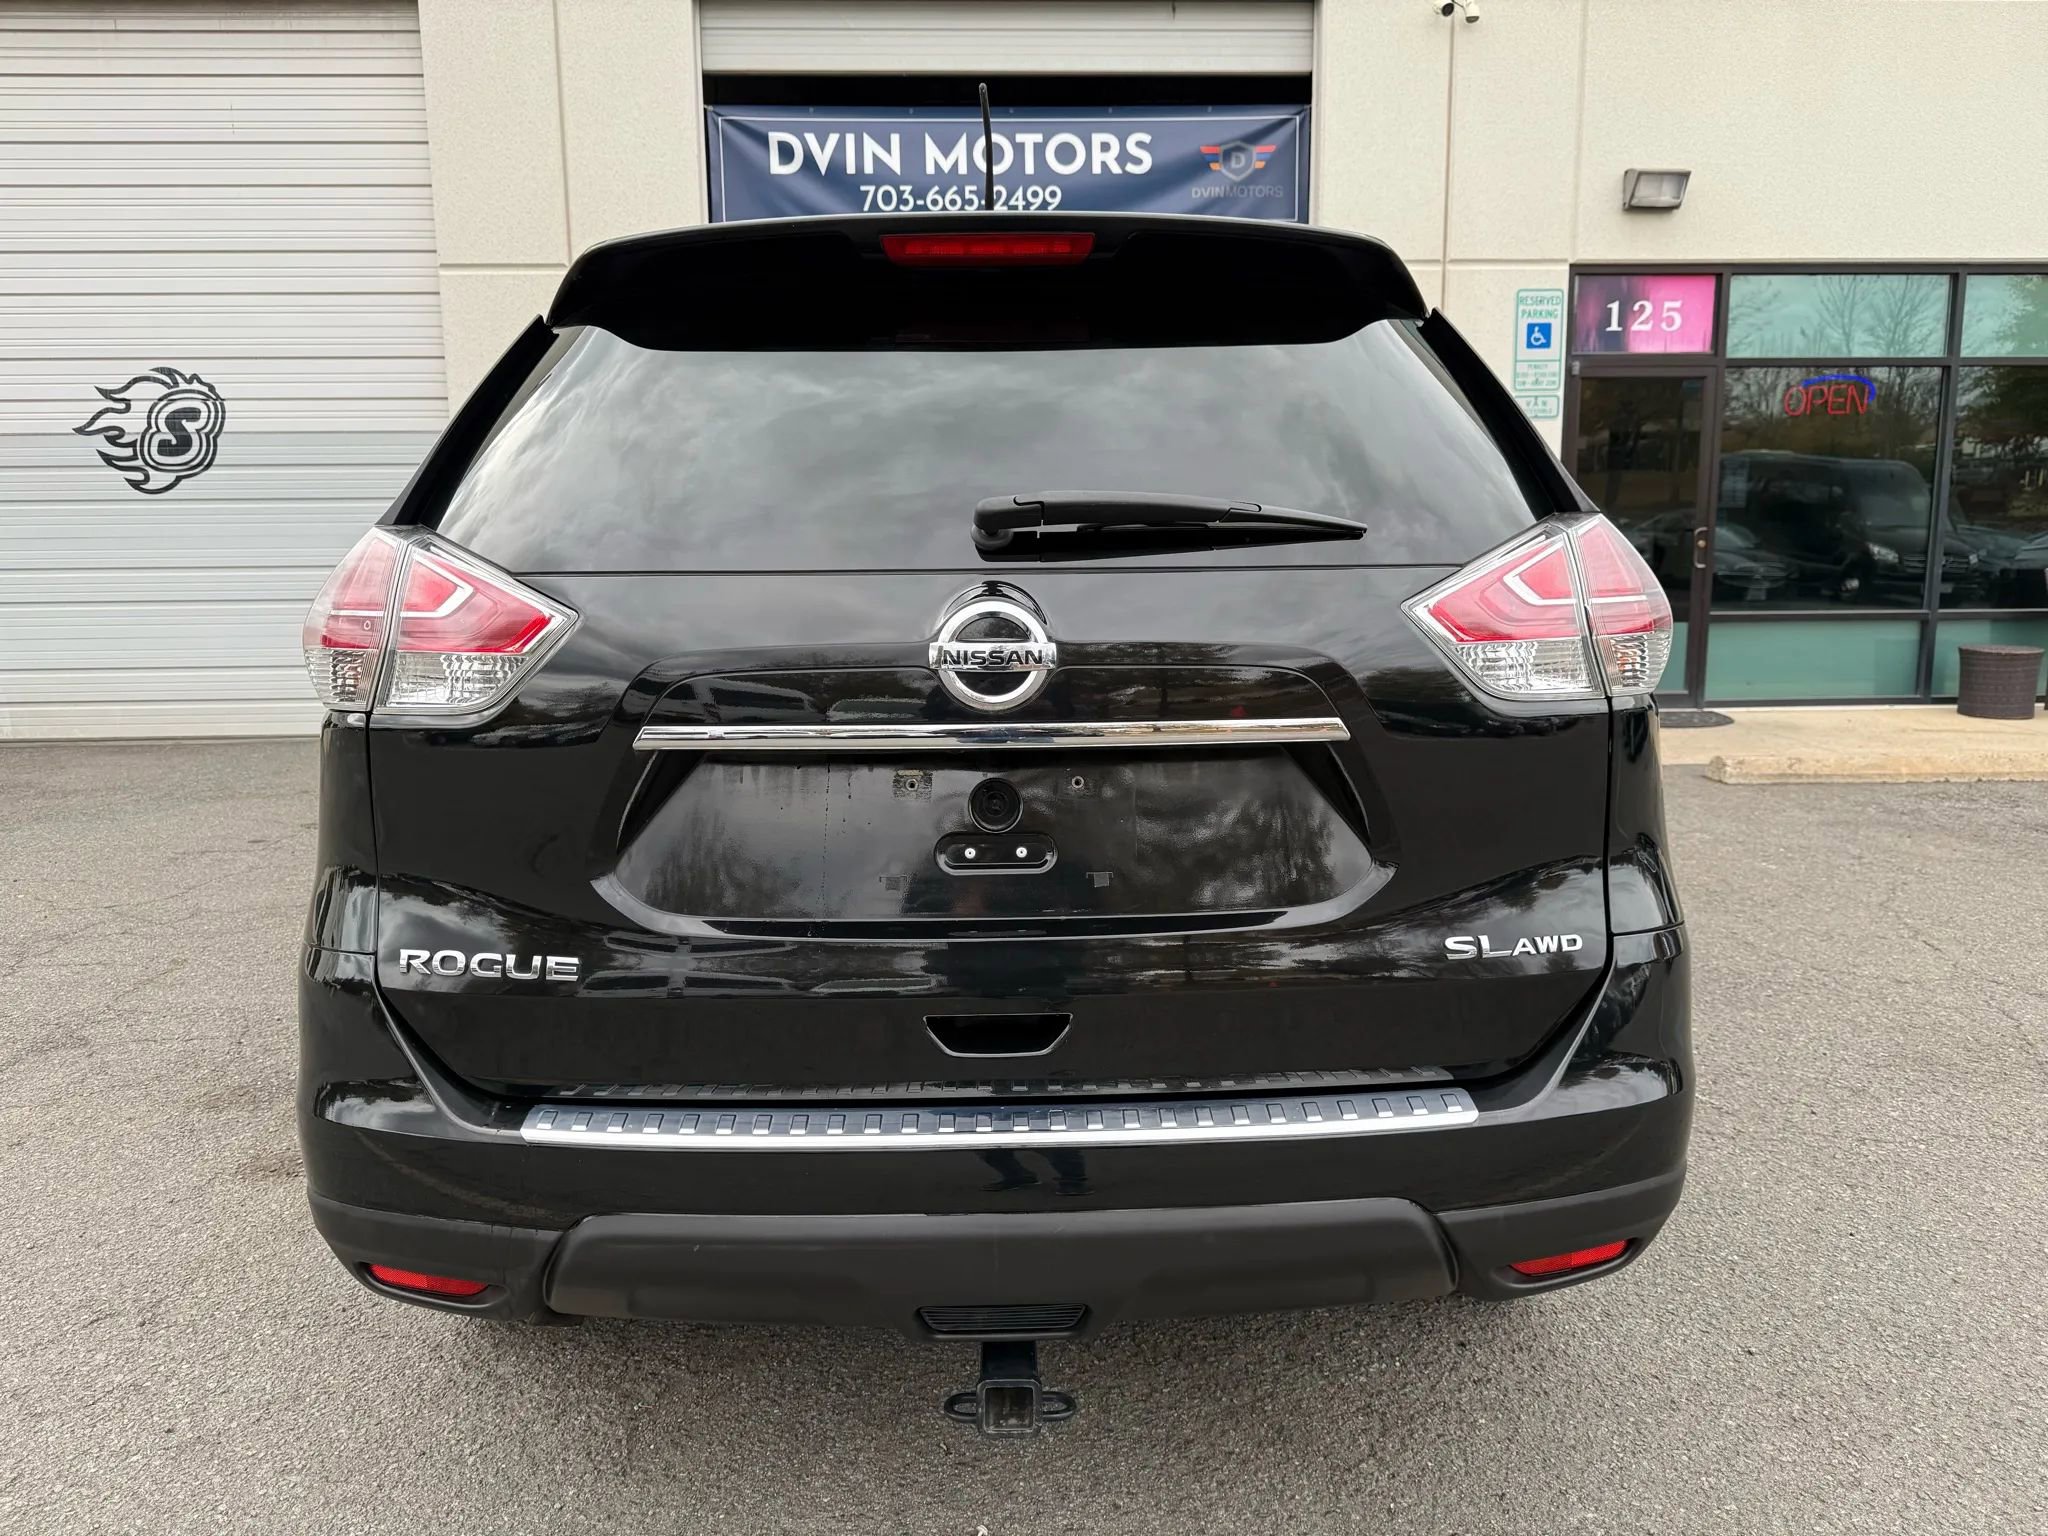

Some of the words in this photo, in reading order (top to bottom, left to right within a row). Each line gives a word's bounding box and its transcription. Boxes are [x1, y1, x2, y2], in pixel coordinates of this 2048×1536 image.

[768, 131, 901, 176] DVIN
[924, 131, 1153, 176] MOTORS
[860, 184, 1062, 212] 703-665-2499
[1519, 295, 1562, 306] RESERVED
[1521, 308, 1559, 319] PARKING
[1605, 299, 1683, 332] 125
[1784, 383, 1869, 416] OPEN
[943, 649, 1043, 665] NISSAN
[399, 948, 580, 982] ROGUE
